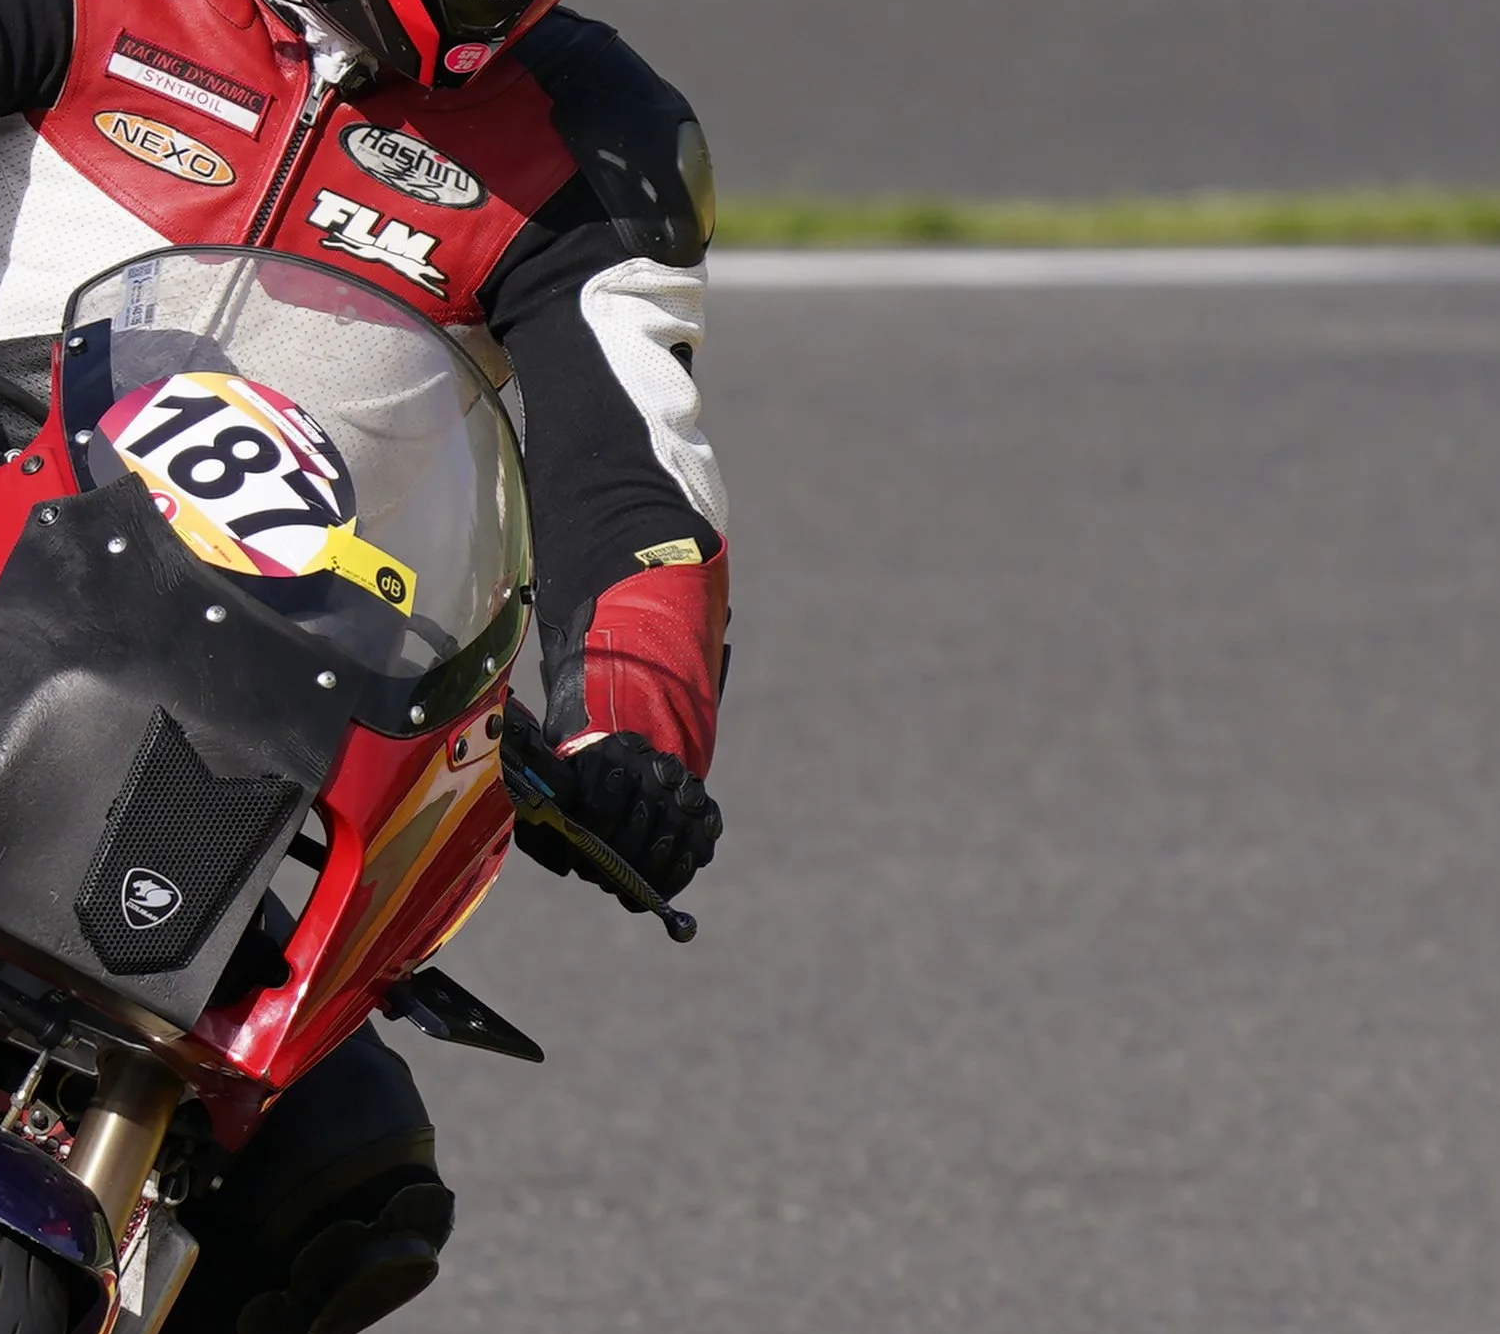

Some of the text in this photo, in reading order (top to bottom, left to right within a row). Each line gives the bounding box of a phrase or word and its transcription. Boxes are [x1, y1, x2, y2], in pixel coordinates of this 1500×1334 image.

[121, 39, 262, 110] RACING DYNAMIC
[142, 69, 223, 114] SYNTHOIL
[111, 117, 217, 179] NEXO
[358, 126, 470, 192] Hashiru
[308, 188, 438, 265] FLM
[125, 394, 347, 541] 187
[381, 575, 402, 598] dB
